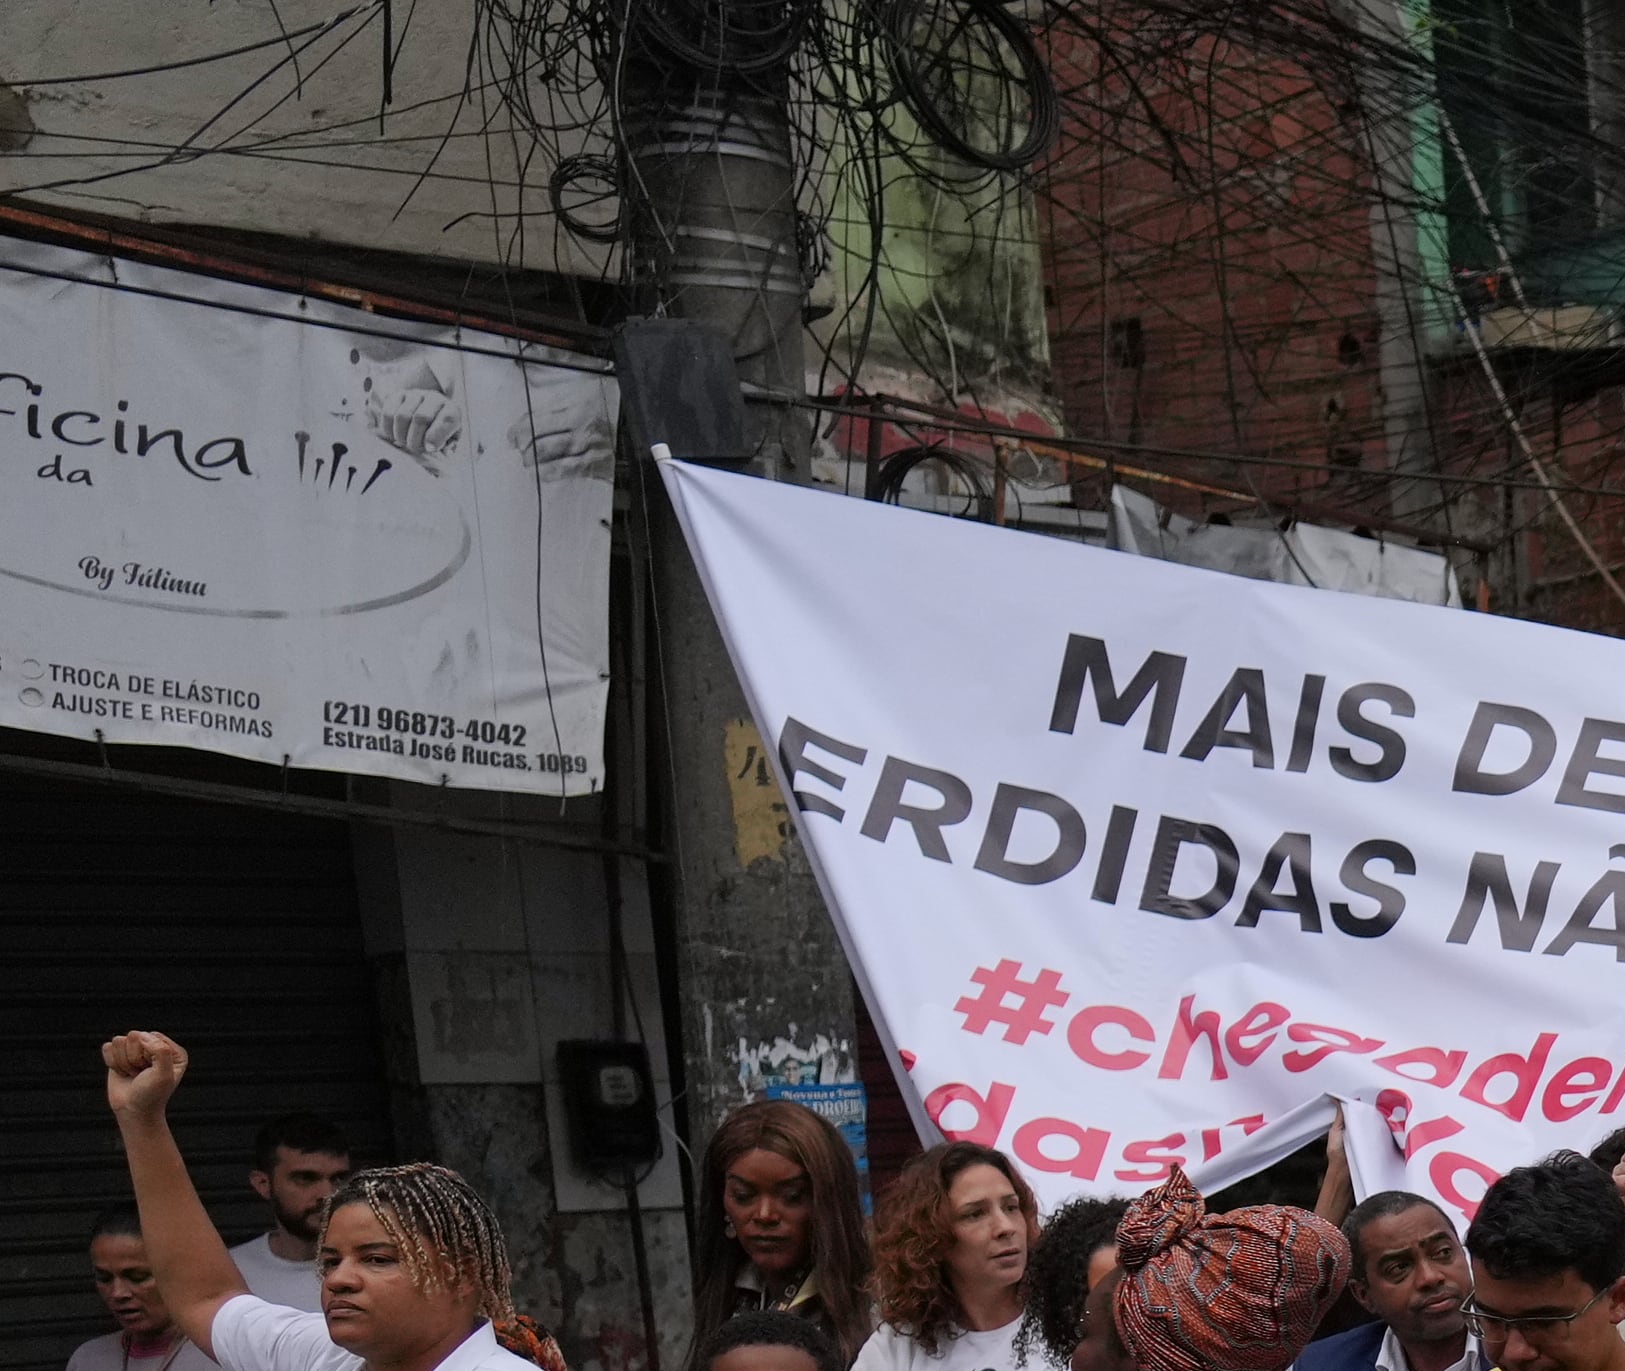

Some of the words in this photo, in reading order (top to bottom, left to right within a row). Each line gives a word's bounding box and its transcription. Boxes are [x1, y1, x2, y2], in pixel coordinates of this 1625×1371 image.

[37, 454, 93, 486] da
[78, 555, 115, 591] By
[49, 663, 120, 691] TROCA
[128, 675, 155, 695] DE
[162, 679, 261, 710] ELÁSTICO
[1049, 632, 1416, 783] MAIS
[52, 692, 134, 719] AJUSTE
[142, 704, 154, 721] E
[161, 706, 273, 738] REFORMAS
[323, 700, 370, 727] (21)
[377, 707, 526, 747] 96873-4042
[323, 726, 404, 756] Estrada
[409, 738, 456, 762] José
